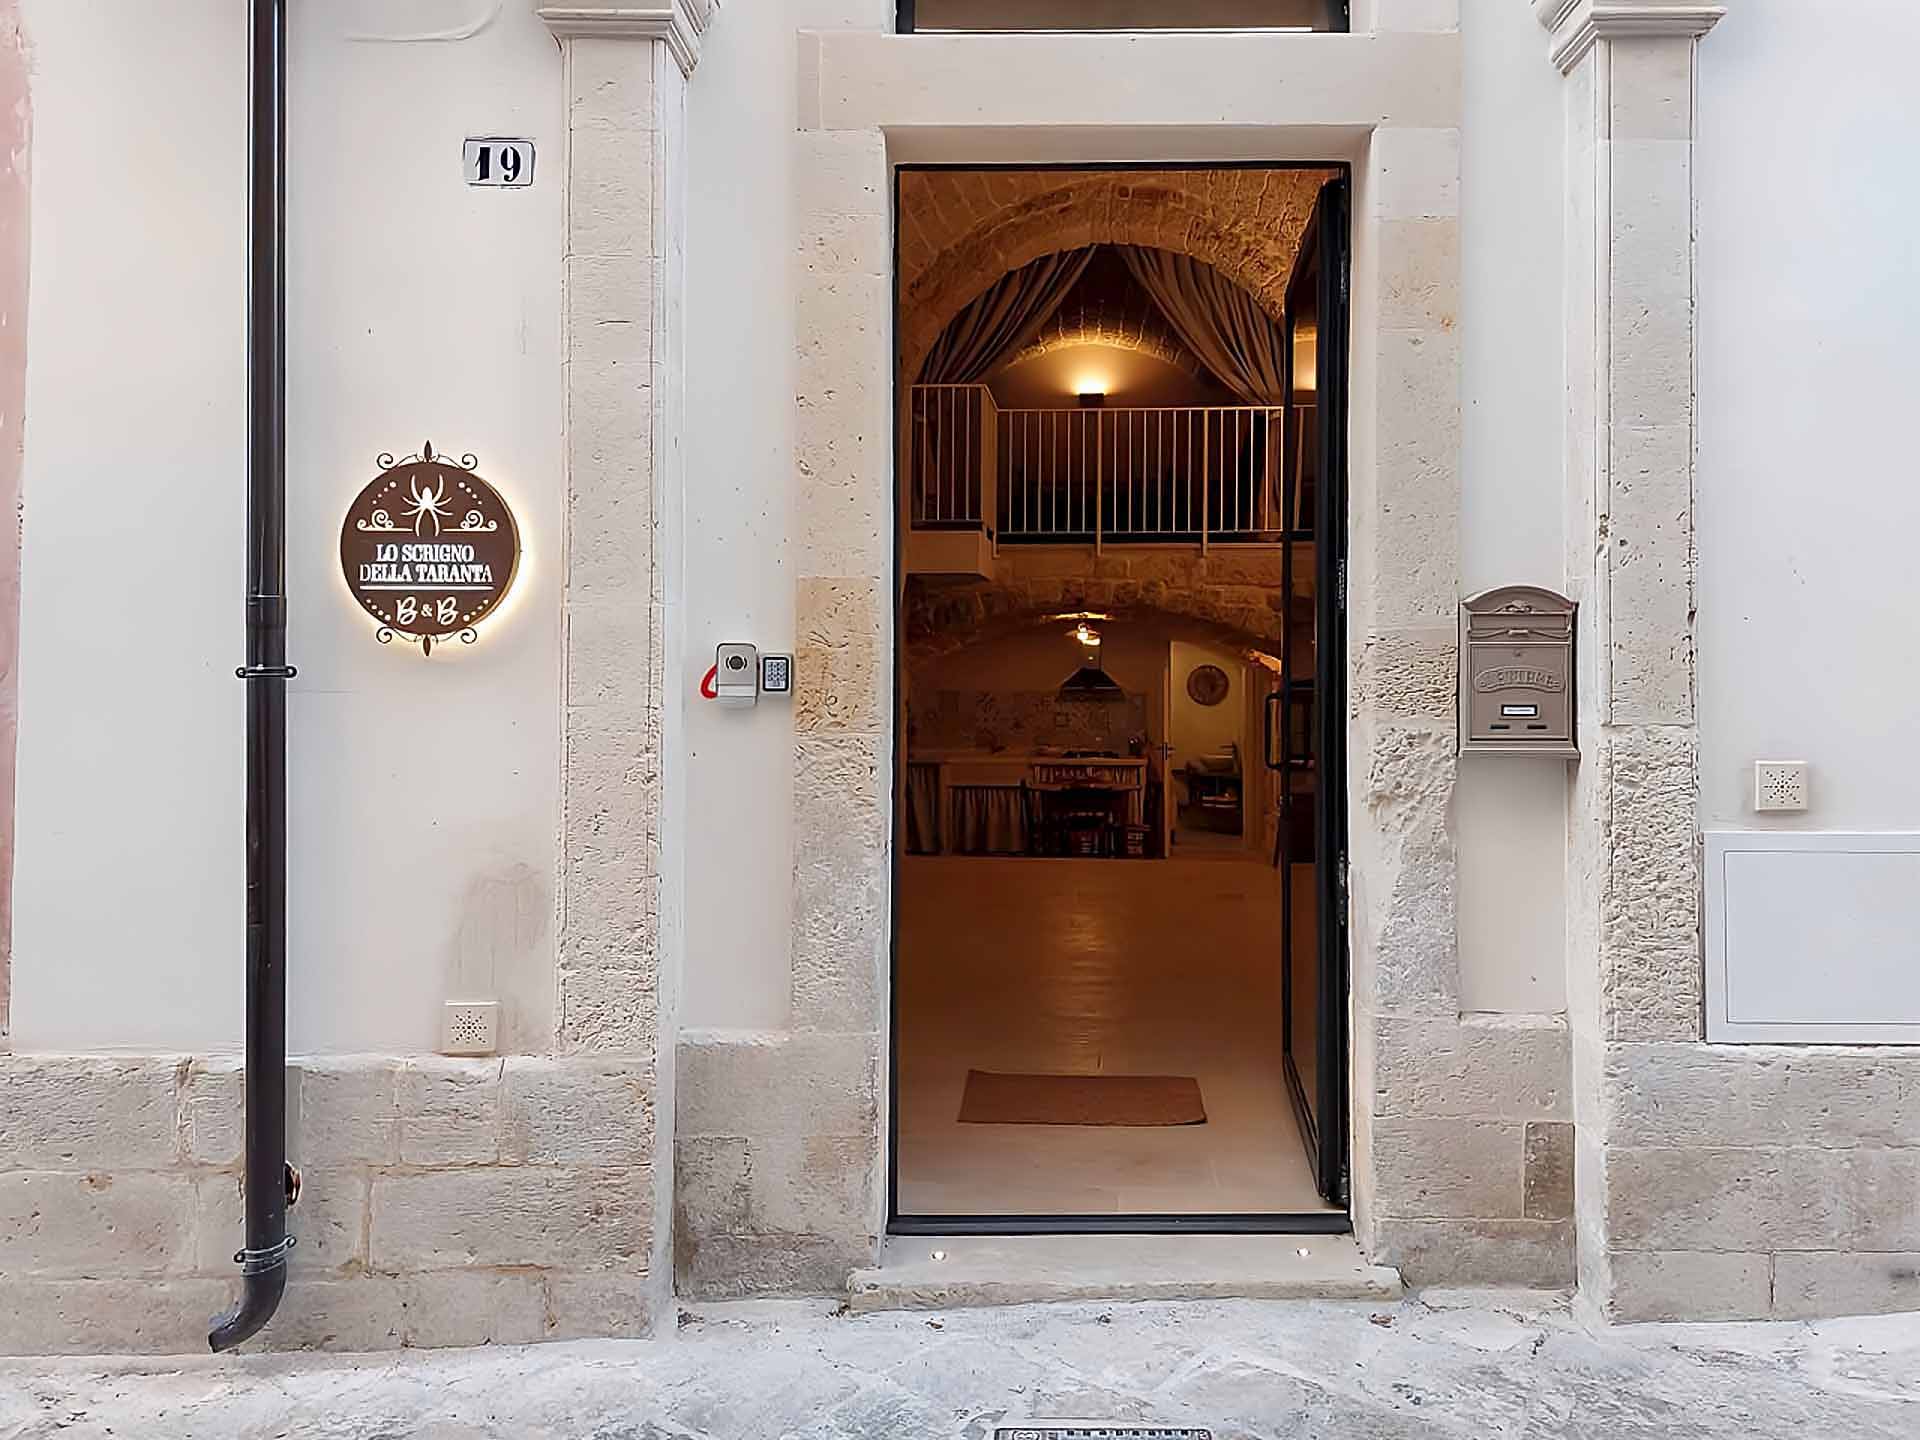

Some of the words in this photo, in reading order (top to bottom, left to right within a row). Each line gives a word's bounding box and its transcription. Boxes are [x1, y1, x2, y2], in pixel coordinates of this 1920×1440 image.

[474, 146, 521, 182] 19
[375, 544, 399, 562] LO
[401, 544, 475, 562] SCRIGNO
[359, 564, 413, 582] DELLA
[415, 564, 493, 582] TARANTA
